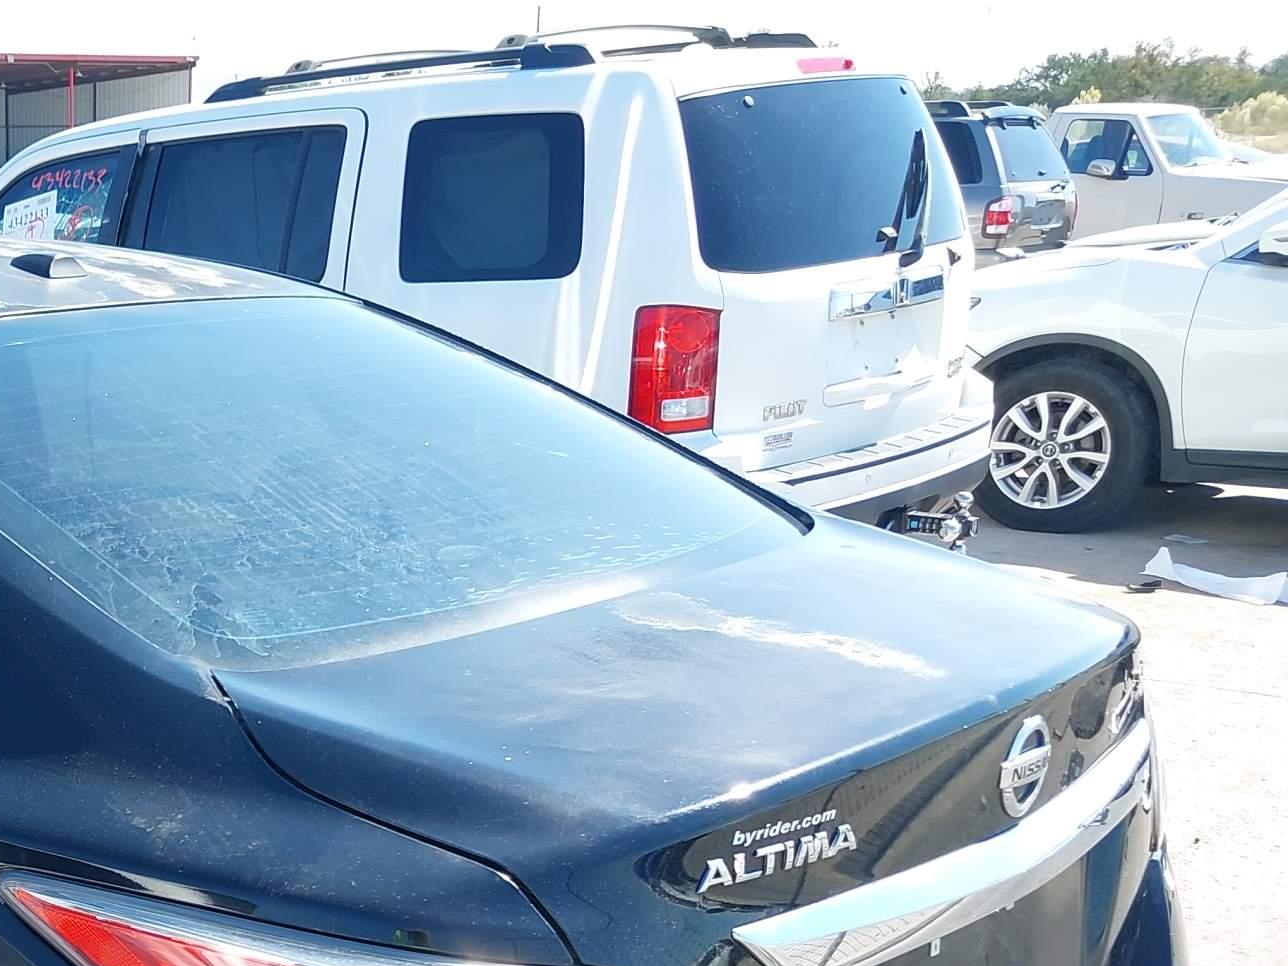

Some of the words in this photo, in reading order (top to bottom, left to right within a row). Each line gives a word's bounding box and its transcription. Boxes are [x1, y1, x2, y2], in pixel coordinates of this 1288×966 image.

[31, 167, 108, 194] 43422133
[732, 808, 838, 848] byrider.com
[695, 823, 858, 895] ALTIMA
